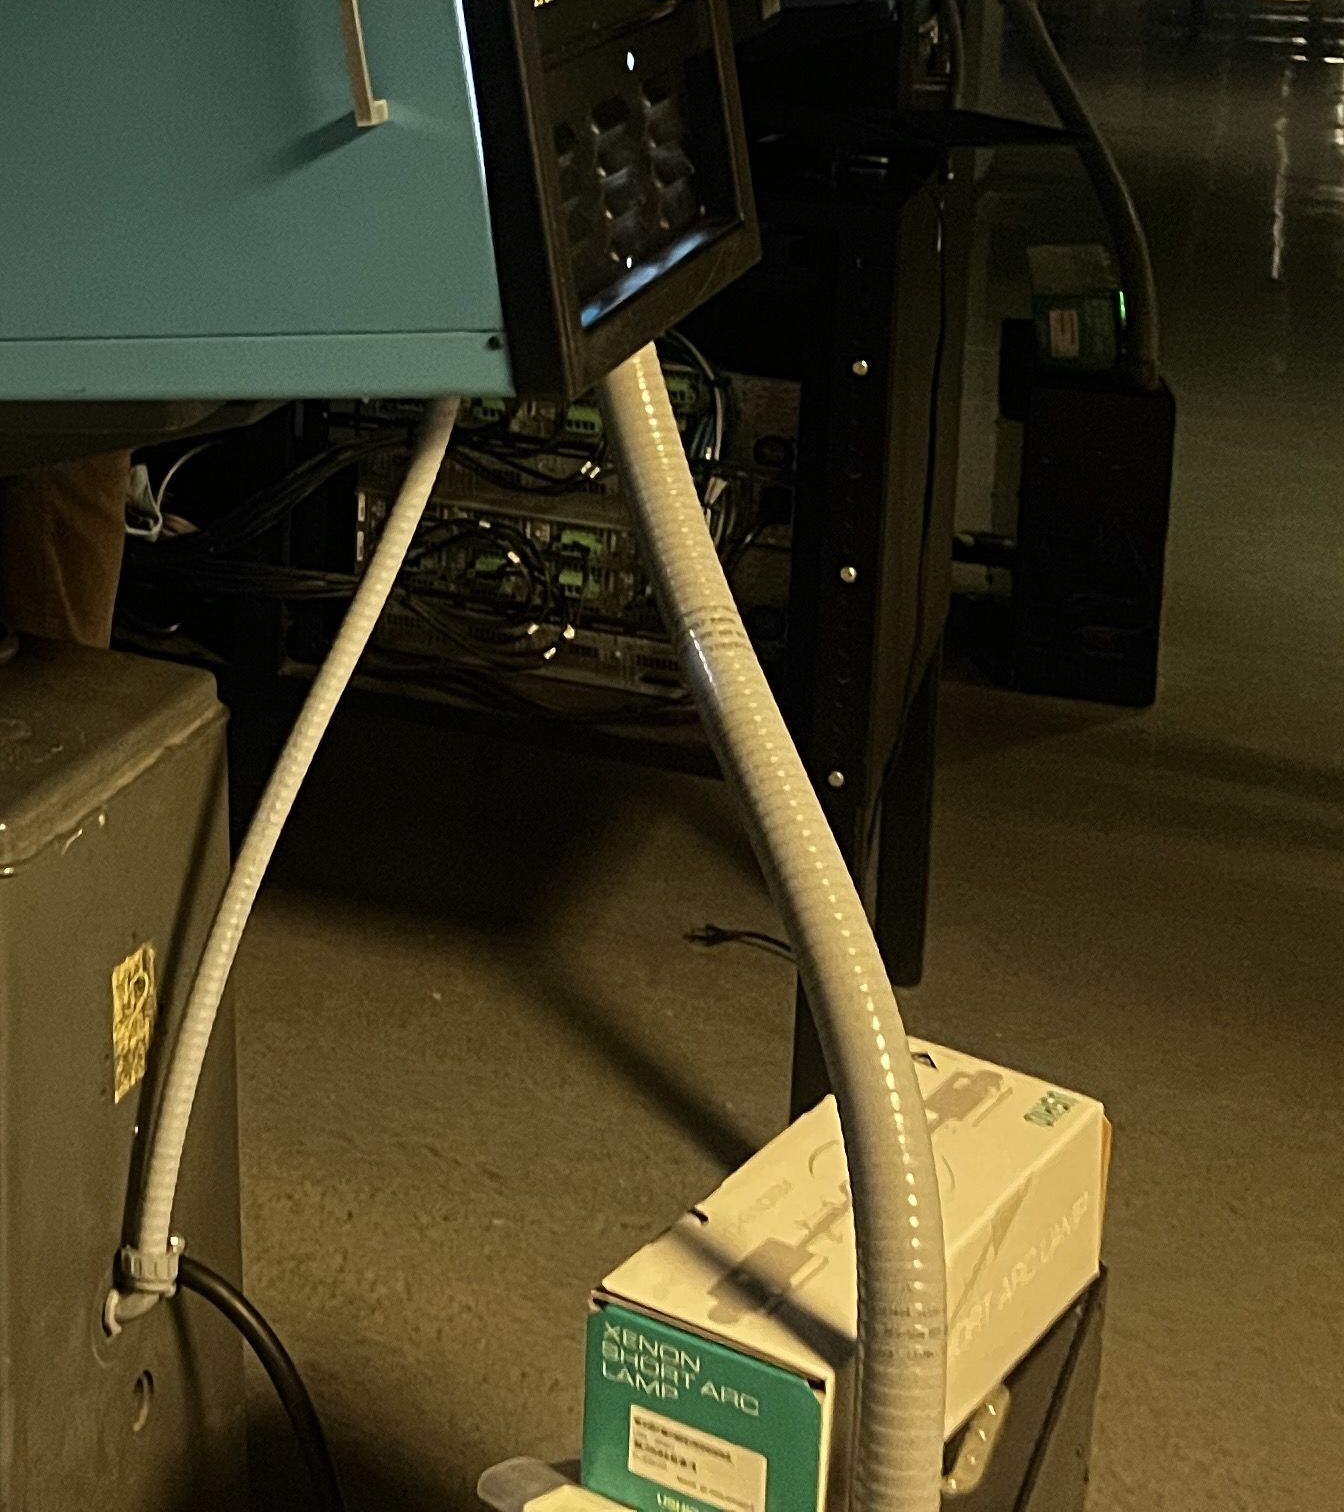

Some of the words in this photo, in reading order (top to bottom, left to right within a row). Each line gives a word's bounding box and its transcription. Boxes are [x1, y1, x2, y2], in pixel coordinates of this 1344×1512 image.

[603, 1320, 700, 1375] XENON
[602, 1339, 696, 1390] SHORT
[701, 1380, 759, 1416] ARC
[603, 1360, 679, 1399] LAMP
